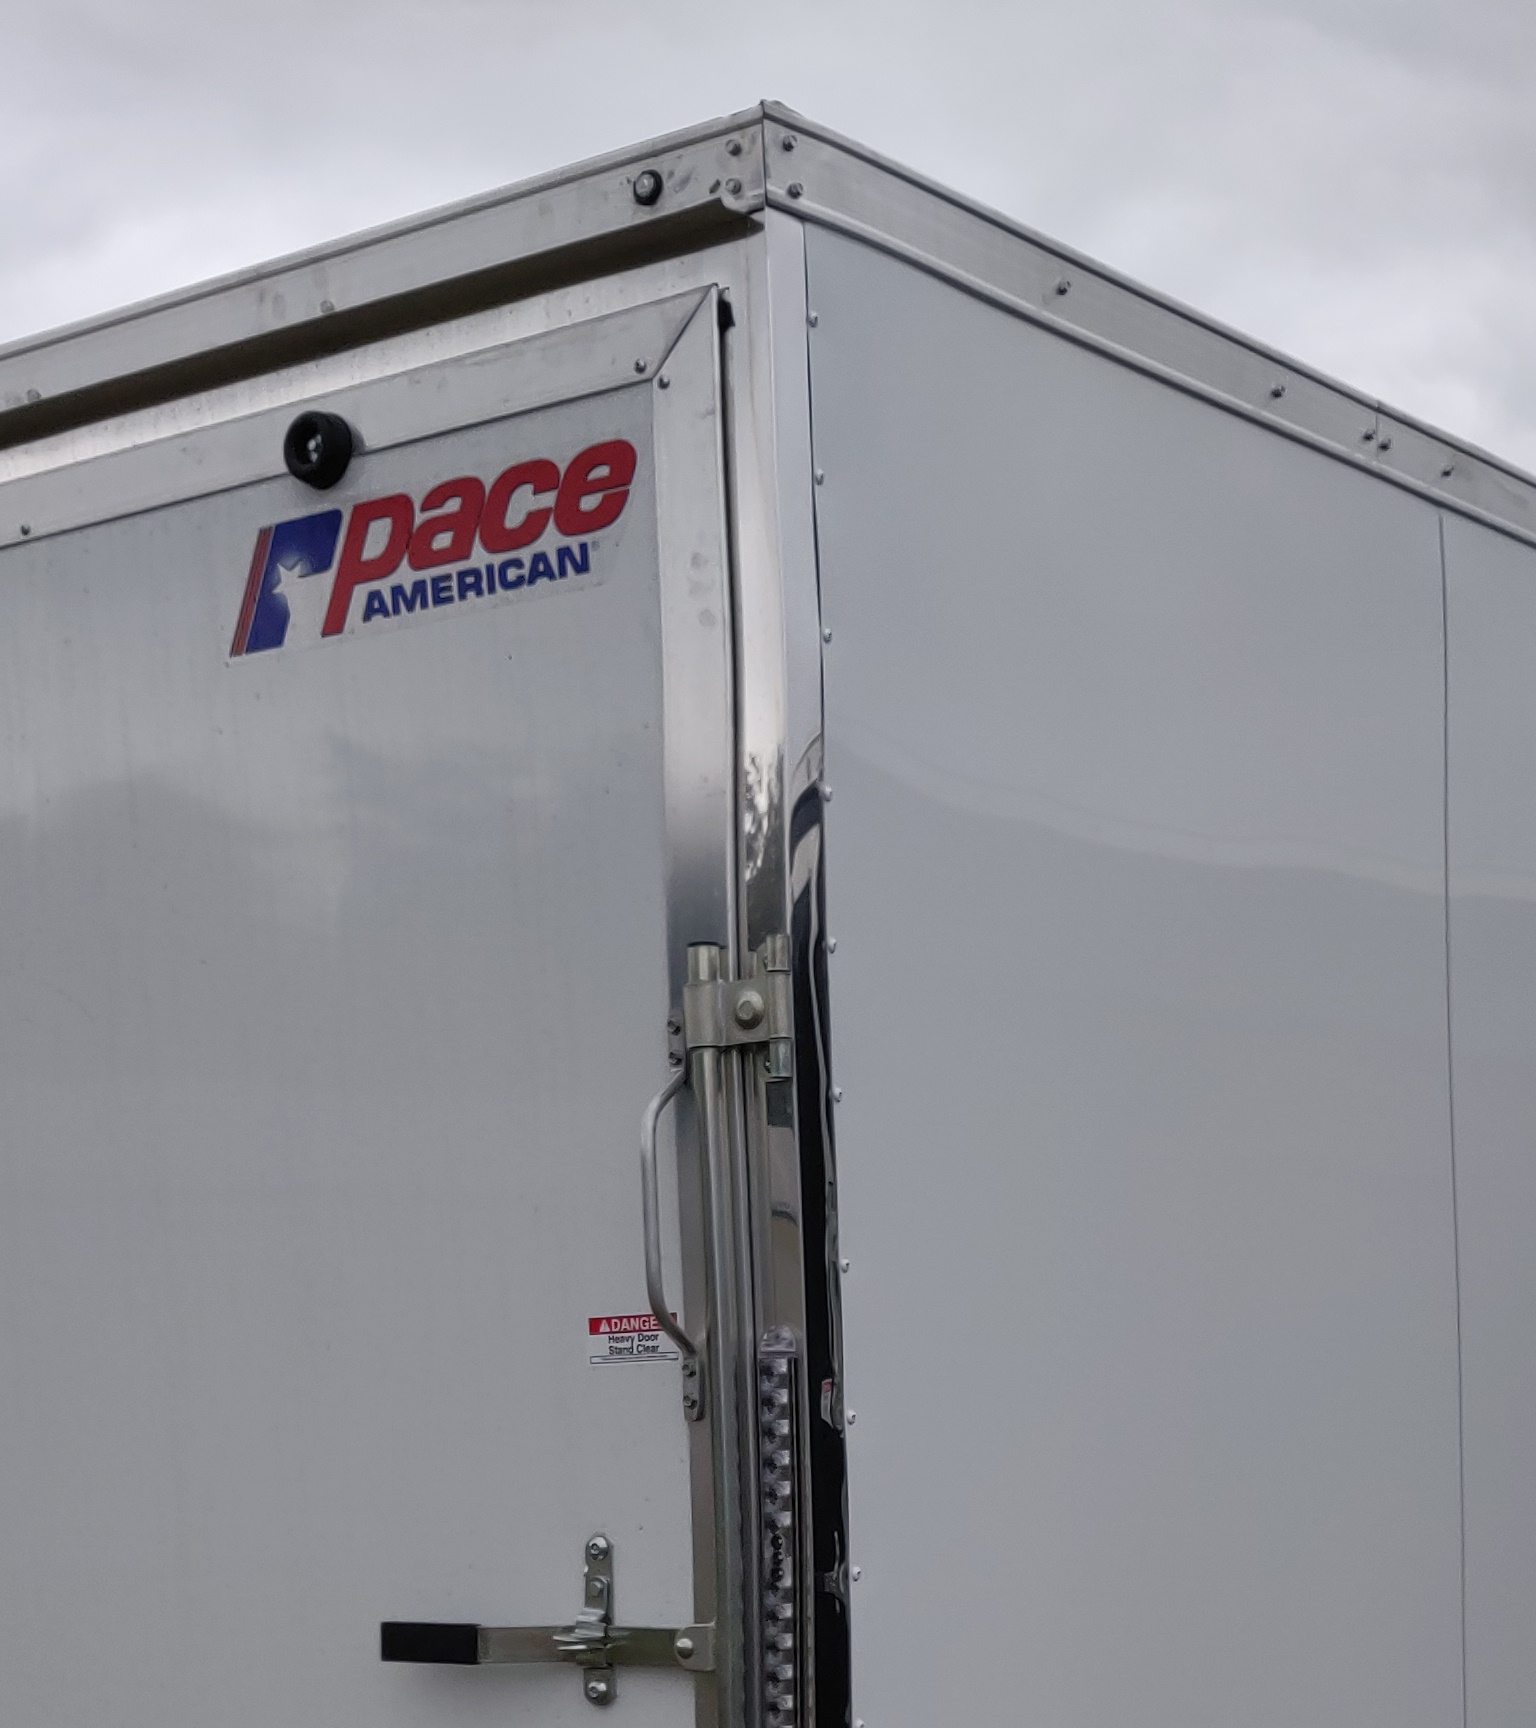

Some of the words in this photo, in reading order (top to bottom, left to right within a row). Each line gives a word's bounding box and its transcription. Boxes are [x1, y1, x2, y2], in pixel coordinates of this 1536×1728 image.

[322, 438, 637, 638] pace
[363, 541, 591, 623] AMERICAN
[611, 1316, 664, 1332] DANGE
[608, 1335, 635, 1346] Heavy
[637, 1333, 659, 1342] Door
[608, 1345, 634, 1355] Stand
[636, 1344, 660, 1354] Clear
